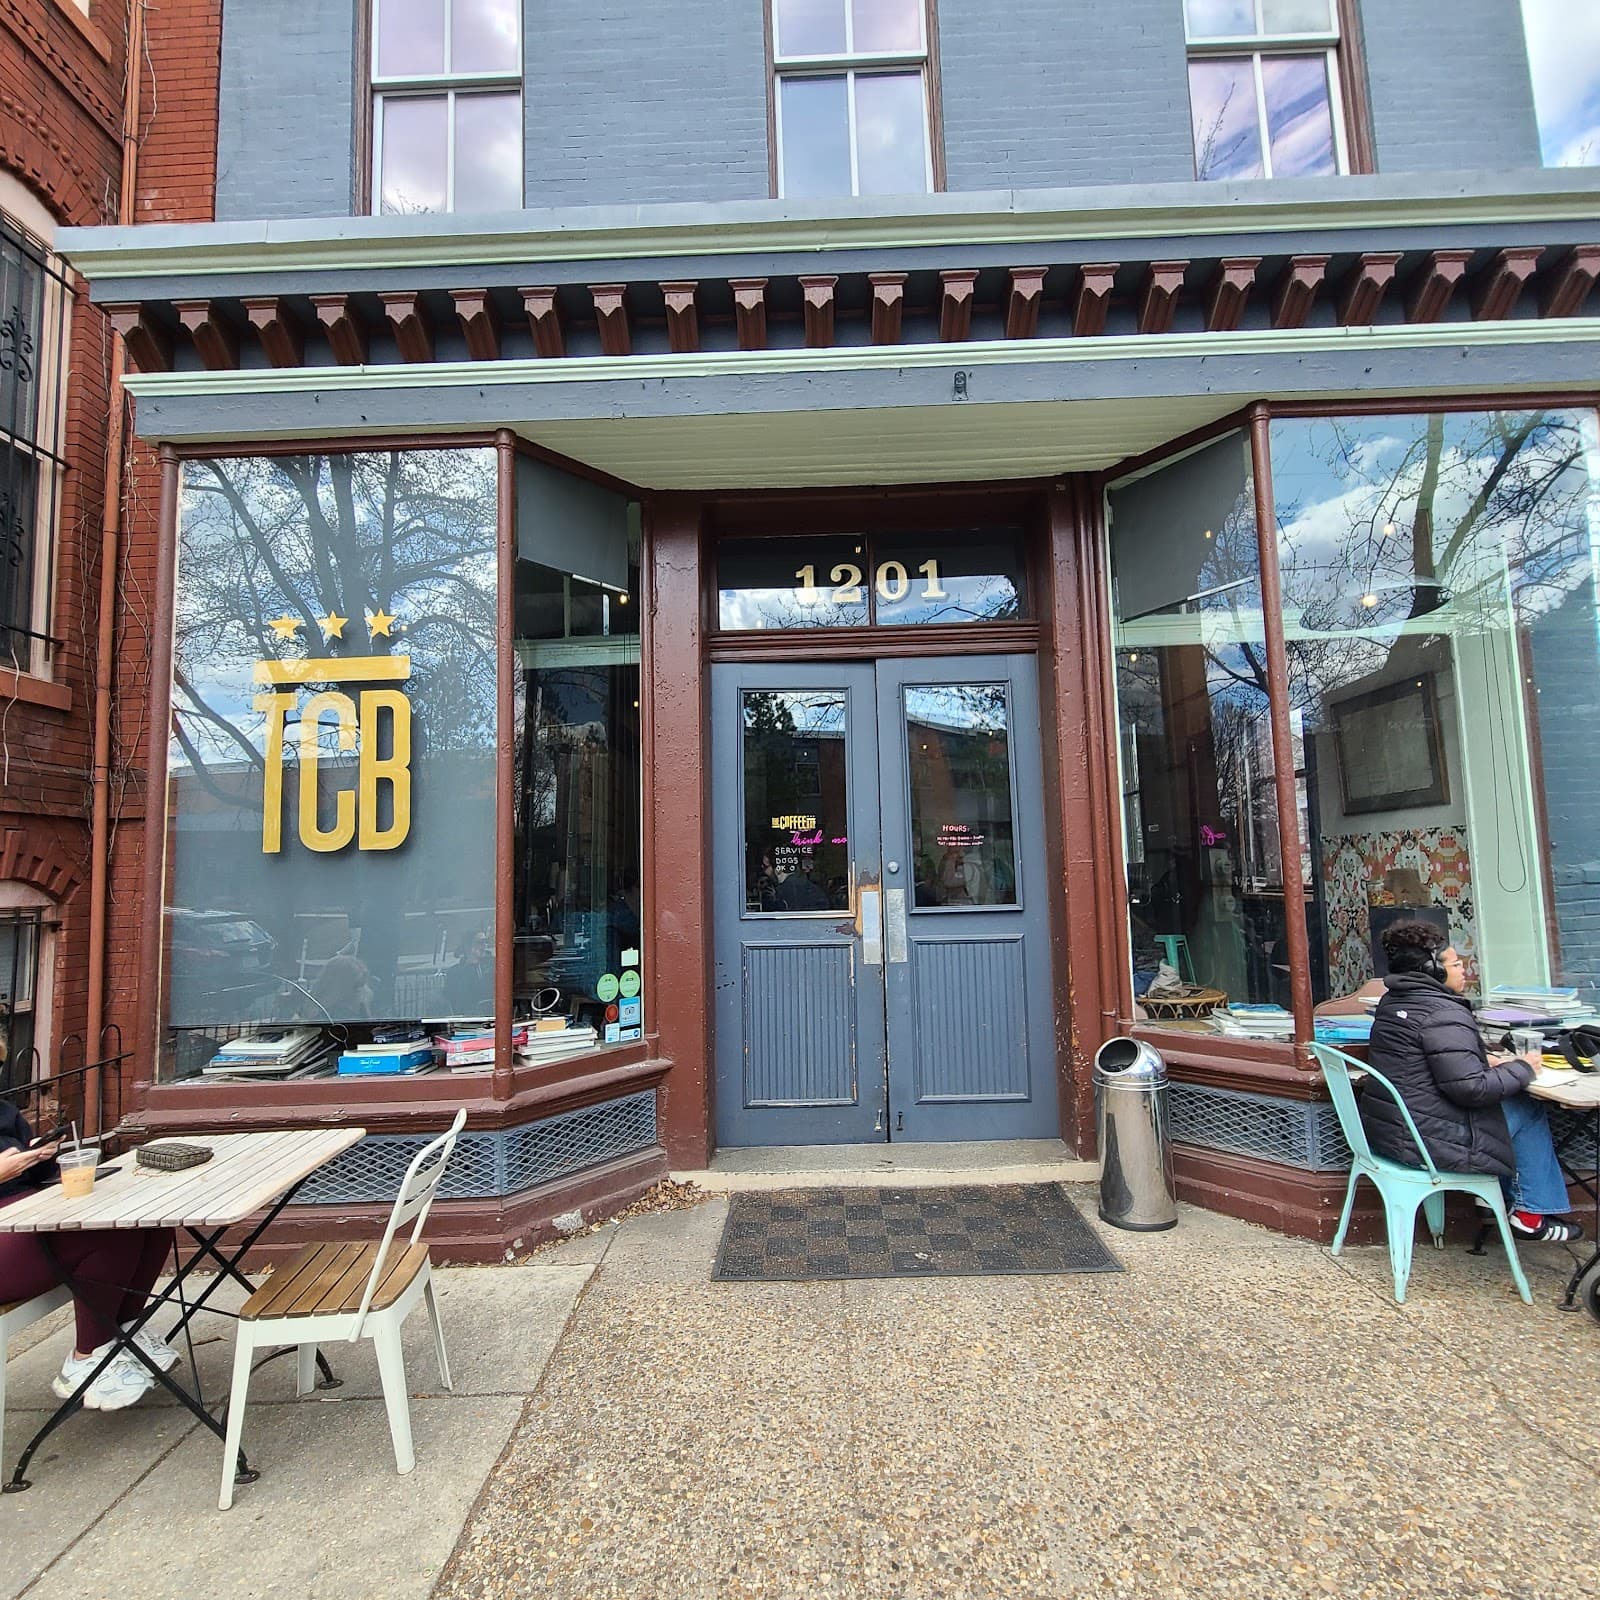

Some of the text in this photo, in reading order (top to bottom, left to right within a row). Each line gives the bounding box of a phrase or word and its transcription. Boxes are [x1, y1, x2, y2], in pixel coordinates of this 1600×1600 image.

[795, 559, 947, 604] 1201
[252, 689, 411, 853] TCB
[780, 815, 808, 830] COFFEE
[774, 846, 813, 855] SERVICE
[775, 857, 798, 865] DOGS
